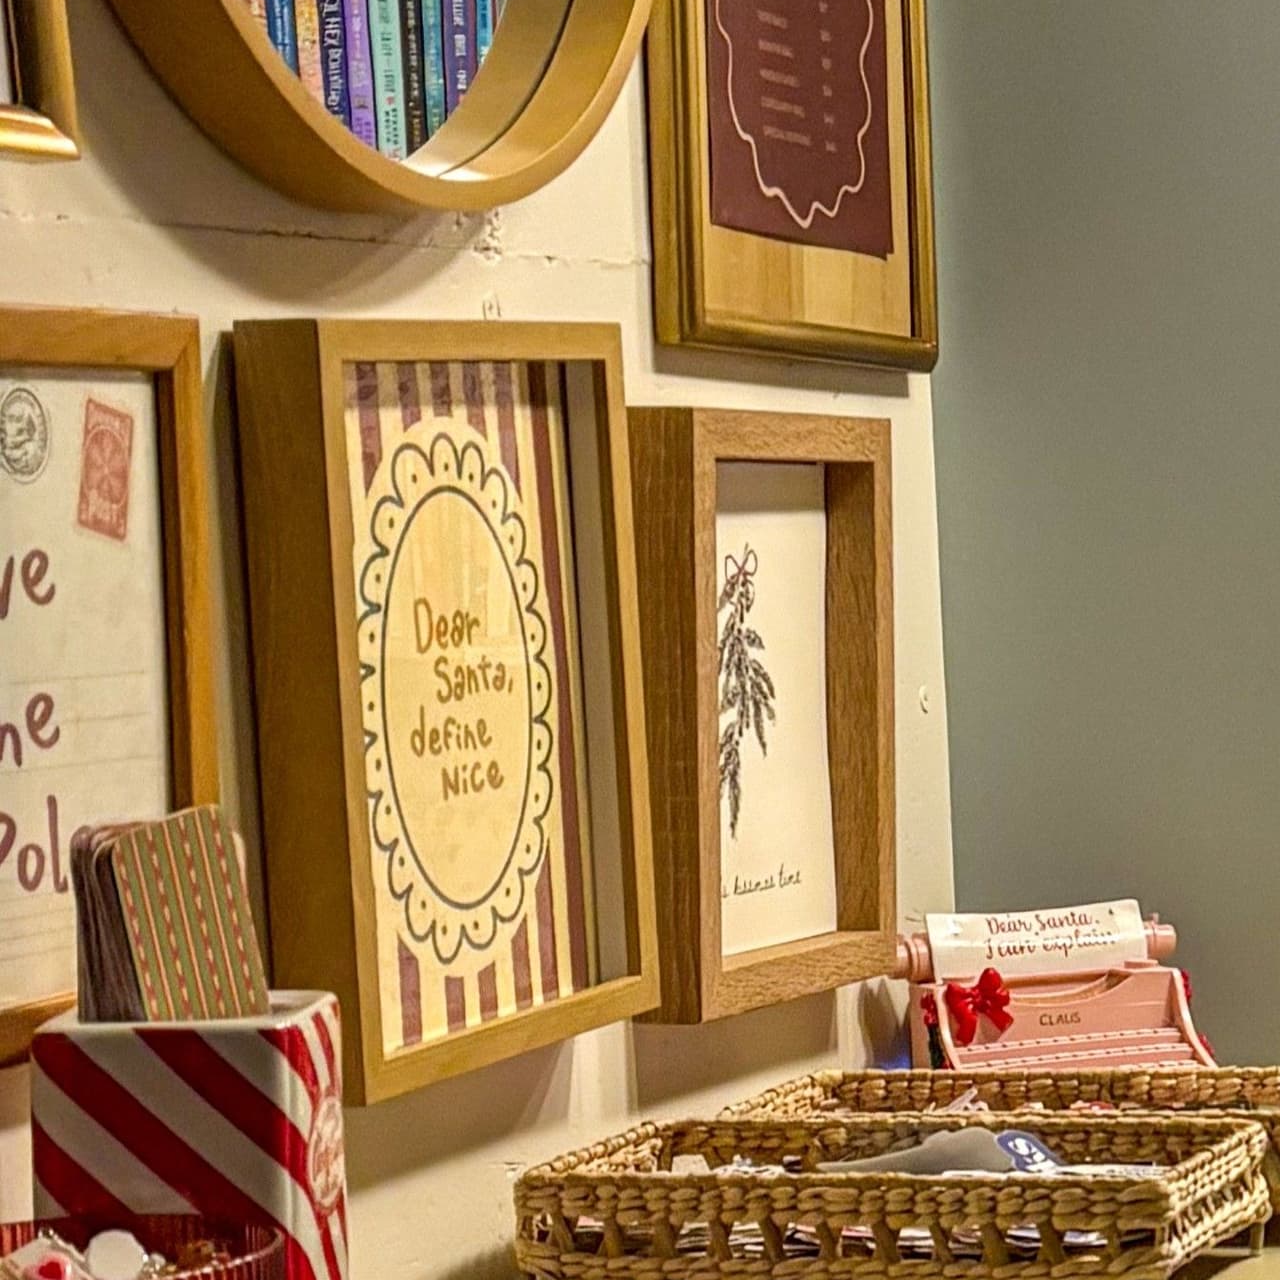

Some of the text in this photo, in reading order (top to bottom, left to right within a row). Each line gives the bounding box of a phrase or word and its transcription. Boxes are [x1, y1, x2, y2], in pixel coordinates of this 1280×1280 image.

[414, 597, 482, 654] Dear
[432, 653, 516, 705] Santa,
[409, 715, 494, 759] define
[985, 913, 1034, 937] Dear
[1041, 929, 1121, 959] explain
[1038, 1011, 1082, 1028] CLAUS
